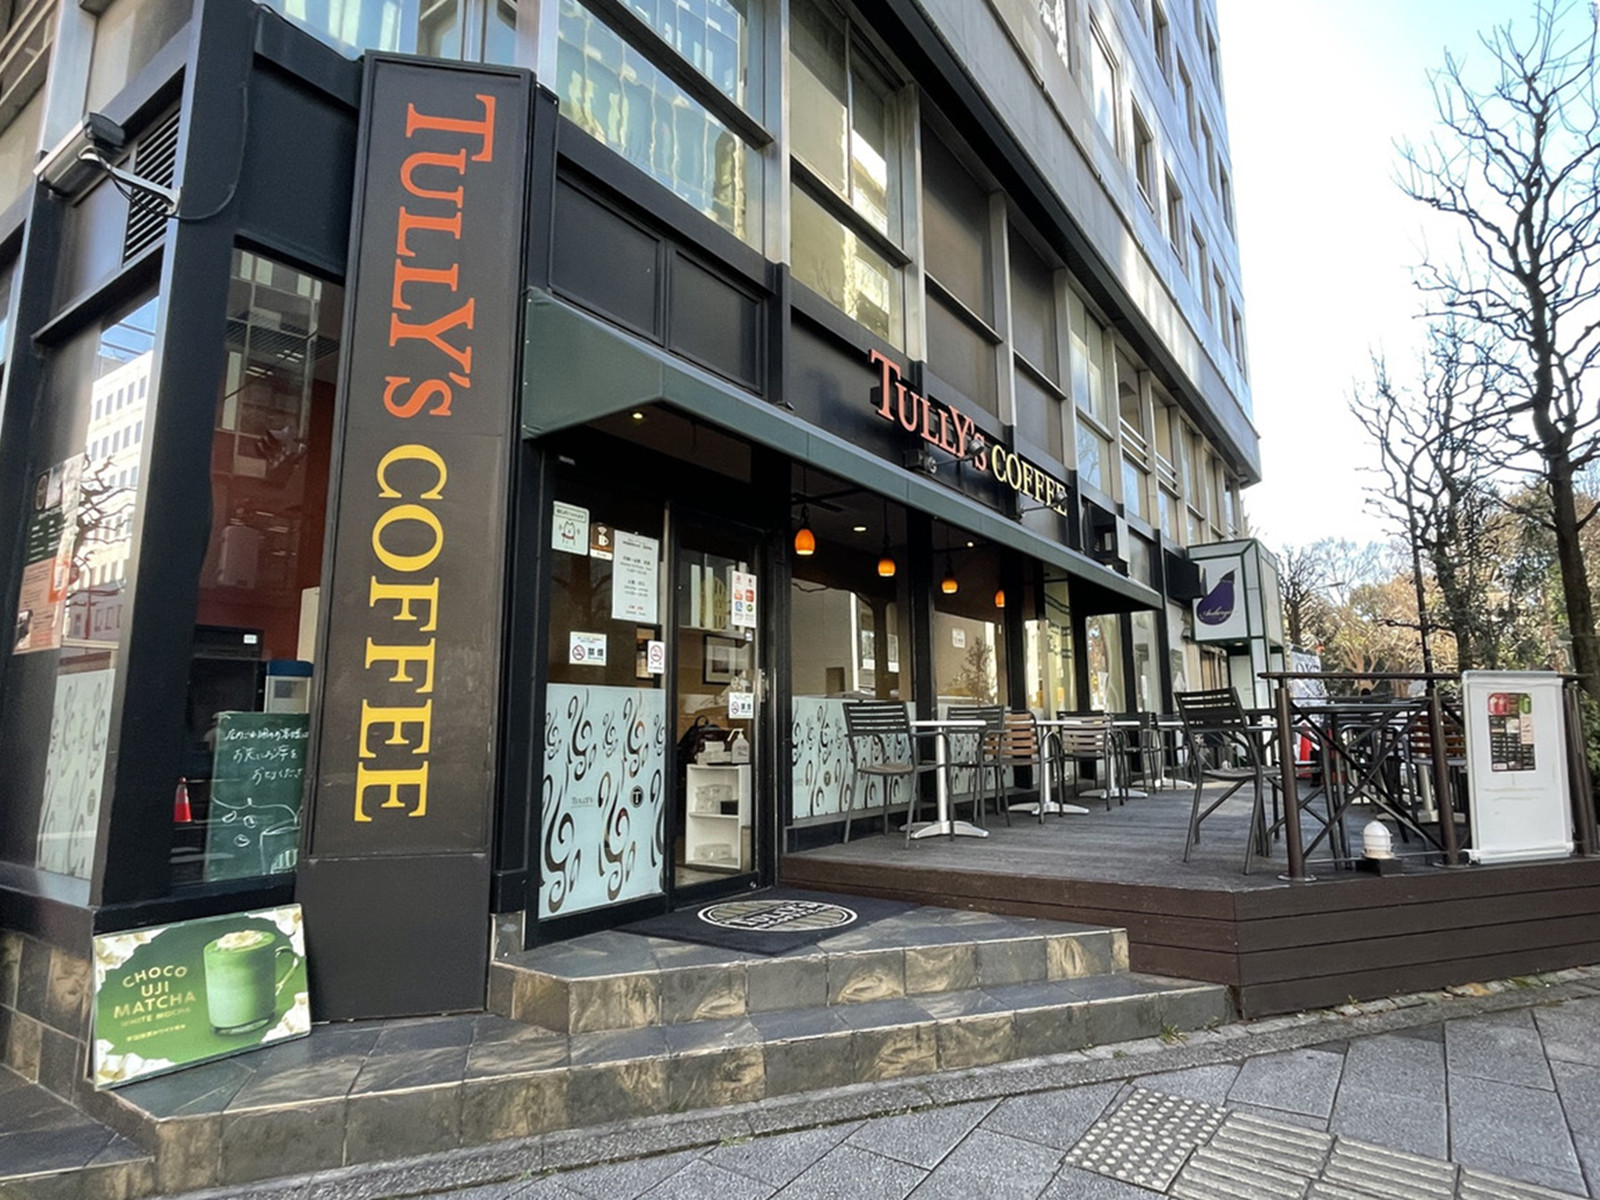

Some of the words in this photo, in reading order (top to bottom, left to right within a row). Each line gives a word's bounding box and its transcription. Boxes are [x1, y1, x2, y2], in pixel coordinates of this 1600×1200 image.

[383, 94, 496, 418] TULLY'S
[868, 349, 988, 472] TULLY'S
[991, 444, 1068, 517] COFFEE
[354, 444, 448, 822] COFFEE
[113, 991, 196, 1019] MATCHA
[122, 965, 188, 988] CHOCO
[141, 981, 169, 997] UJI
